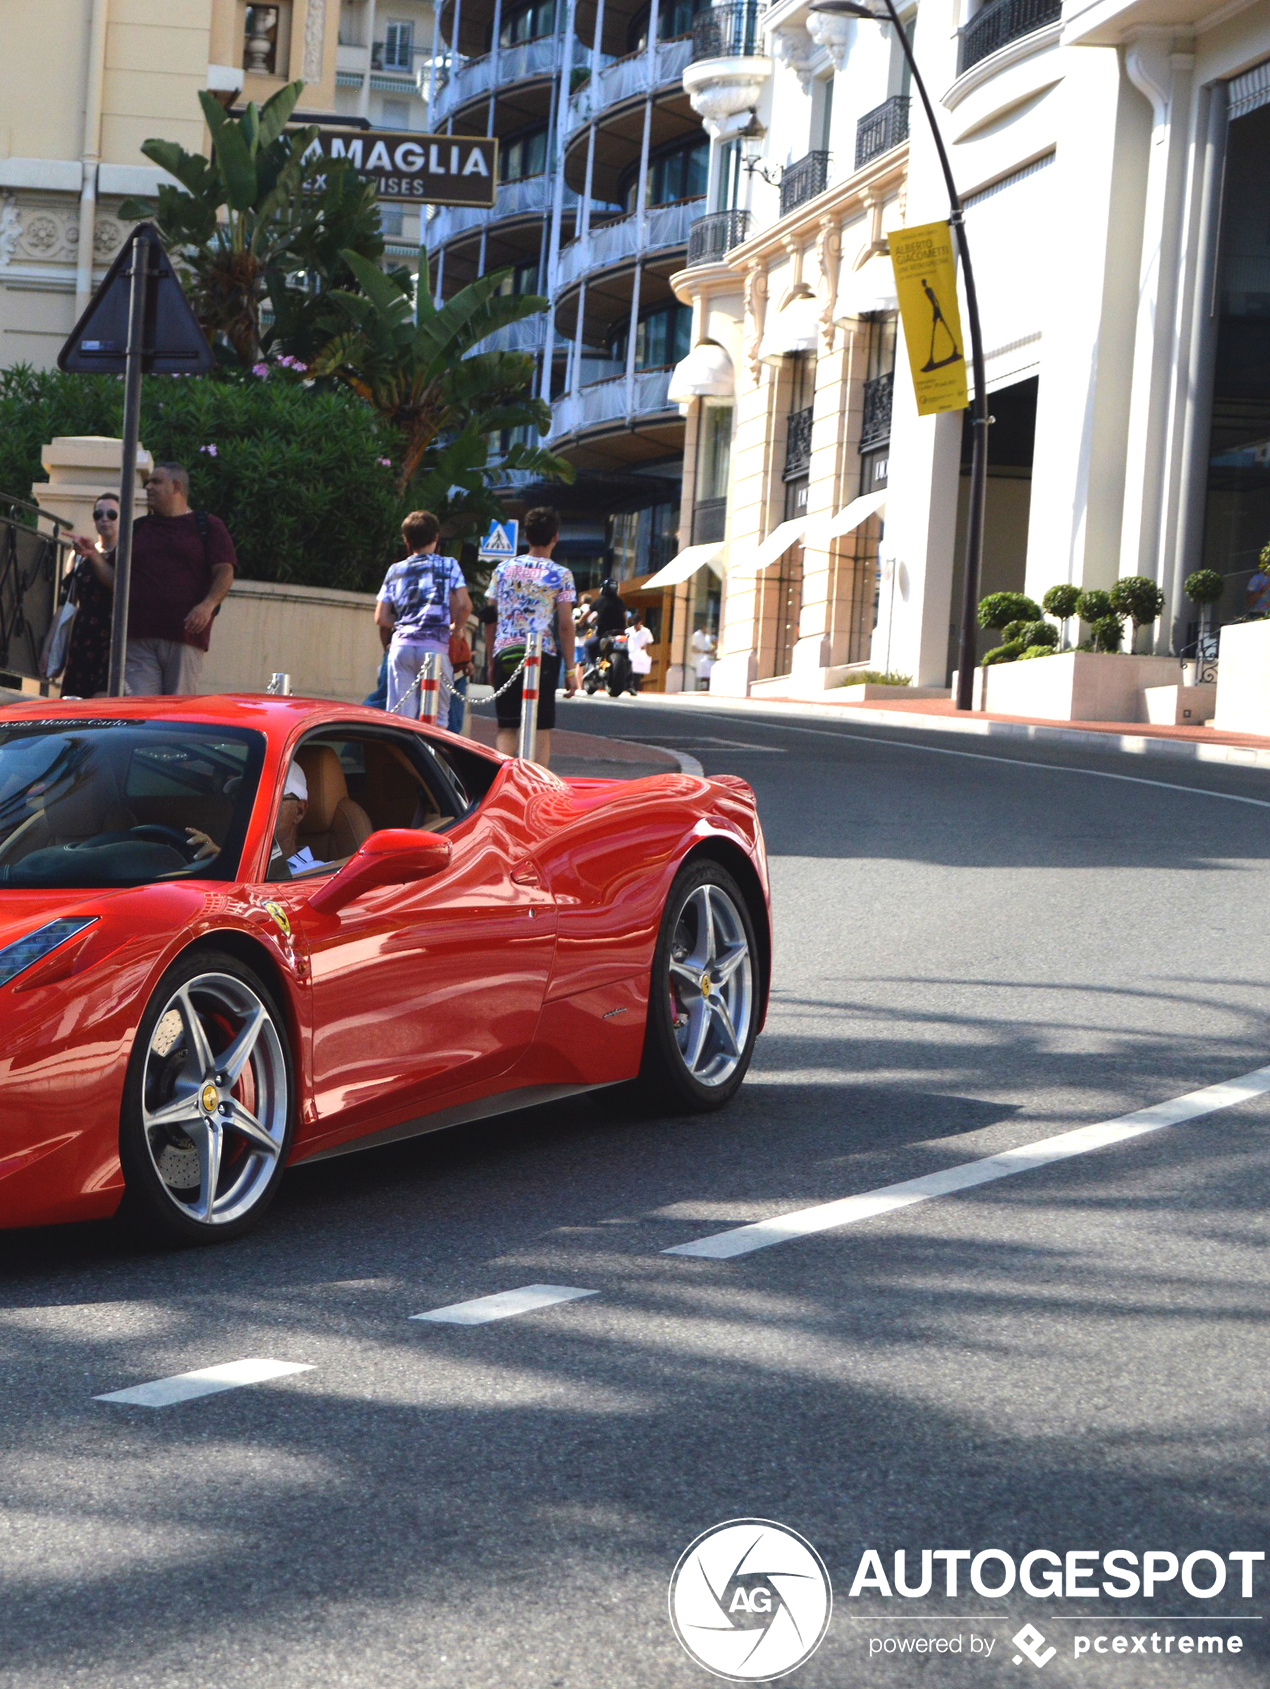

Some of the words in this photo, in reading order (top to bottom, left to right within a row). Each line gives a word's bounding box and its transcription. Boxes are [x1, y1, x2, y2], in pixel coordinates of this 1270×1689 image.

[278, 135, 489, 176] AMAGLIA
[895, 239, 933, 255] ALBERTO
[896, 246, 949, 265] GIACOMETTI
